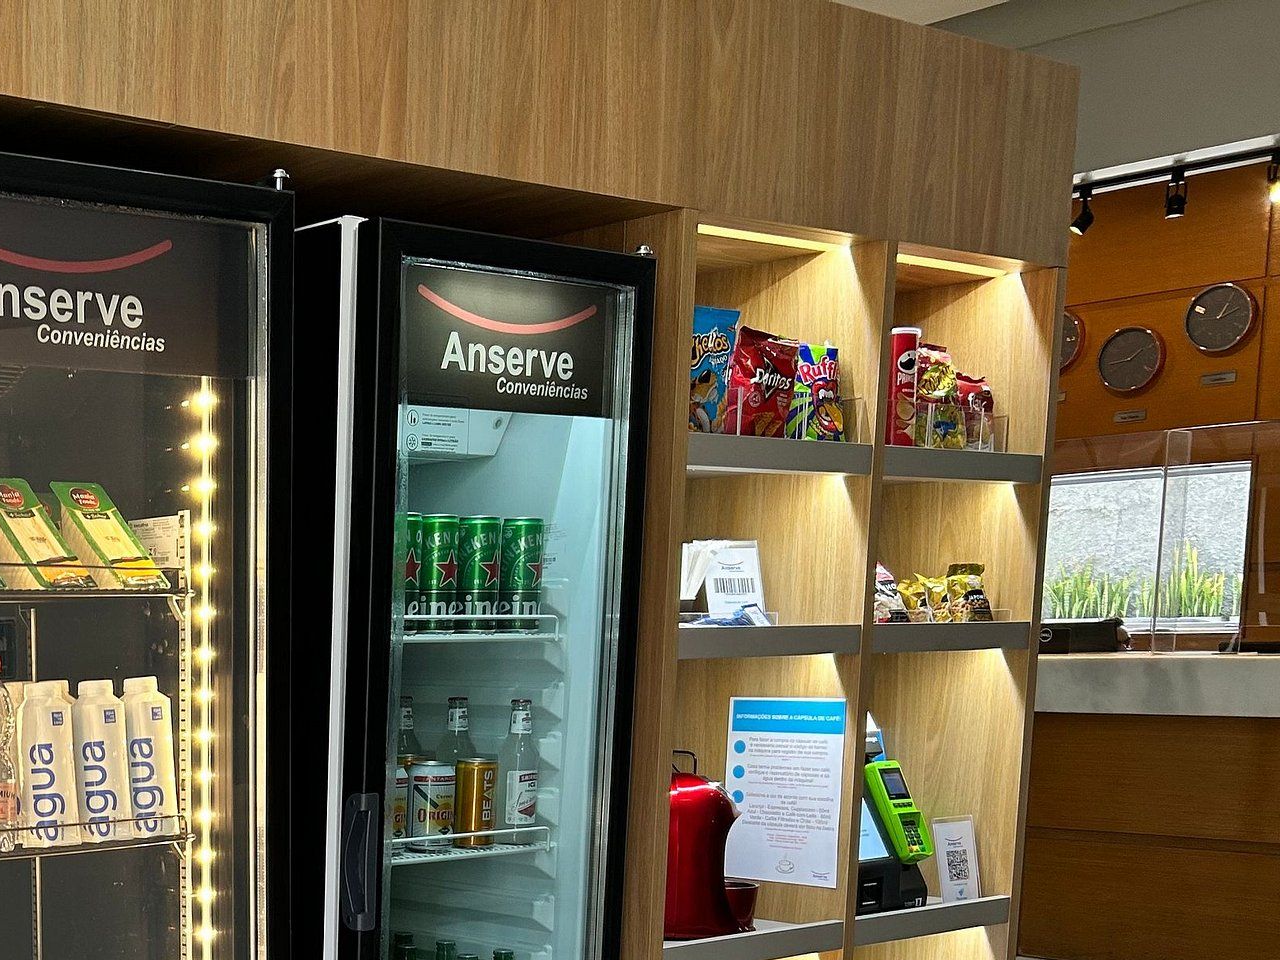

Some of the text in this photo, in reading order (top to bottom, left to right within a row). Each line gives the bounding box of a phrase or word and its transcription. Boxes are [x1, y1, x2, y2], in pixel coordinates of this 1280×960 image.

[36, 323, 166, 353] Conveniências
[440, 331, 574, 381] Anserve
[496, 376, 589, 401] Conveniências
[755, 368, 792, 390] Doritos
[482, 770, 493, 821] BEATS
